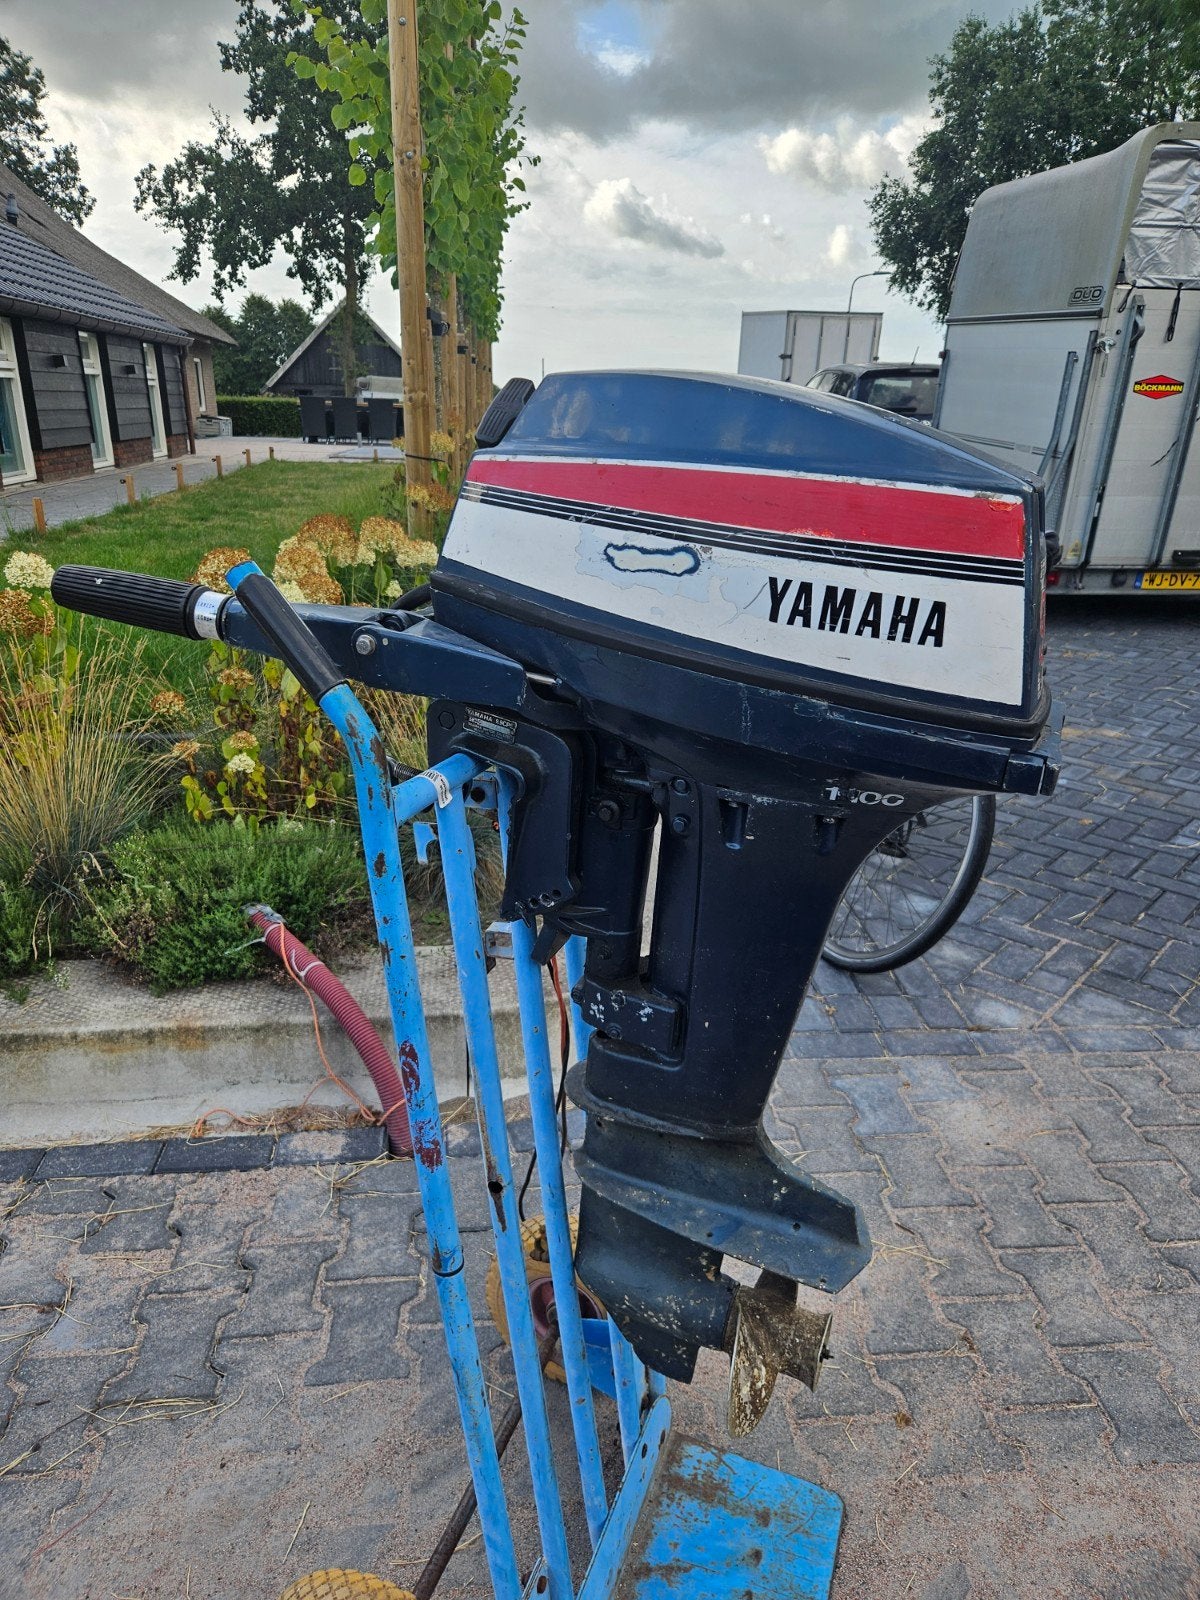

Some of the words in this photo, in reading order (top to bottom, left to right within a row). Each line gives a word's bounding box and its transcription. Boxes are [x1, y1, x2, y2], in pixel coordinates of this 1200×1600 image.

[1072, 286, 1104, 301] DUO
[1134, 382, 1183, 392] BÖCKMANN
[768, 576, 946, 648] YAMAHA
[467, 709, 493, 722] YAMAHA
[825, 786, 905, 807] 100
